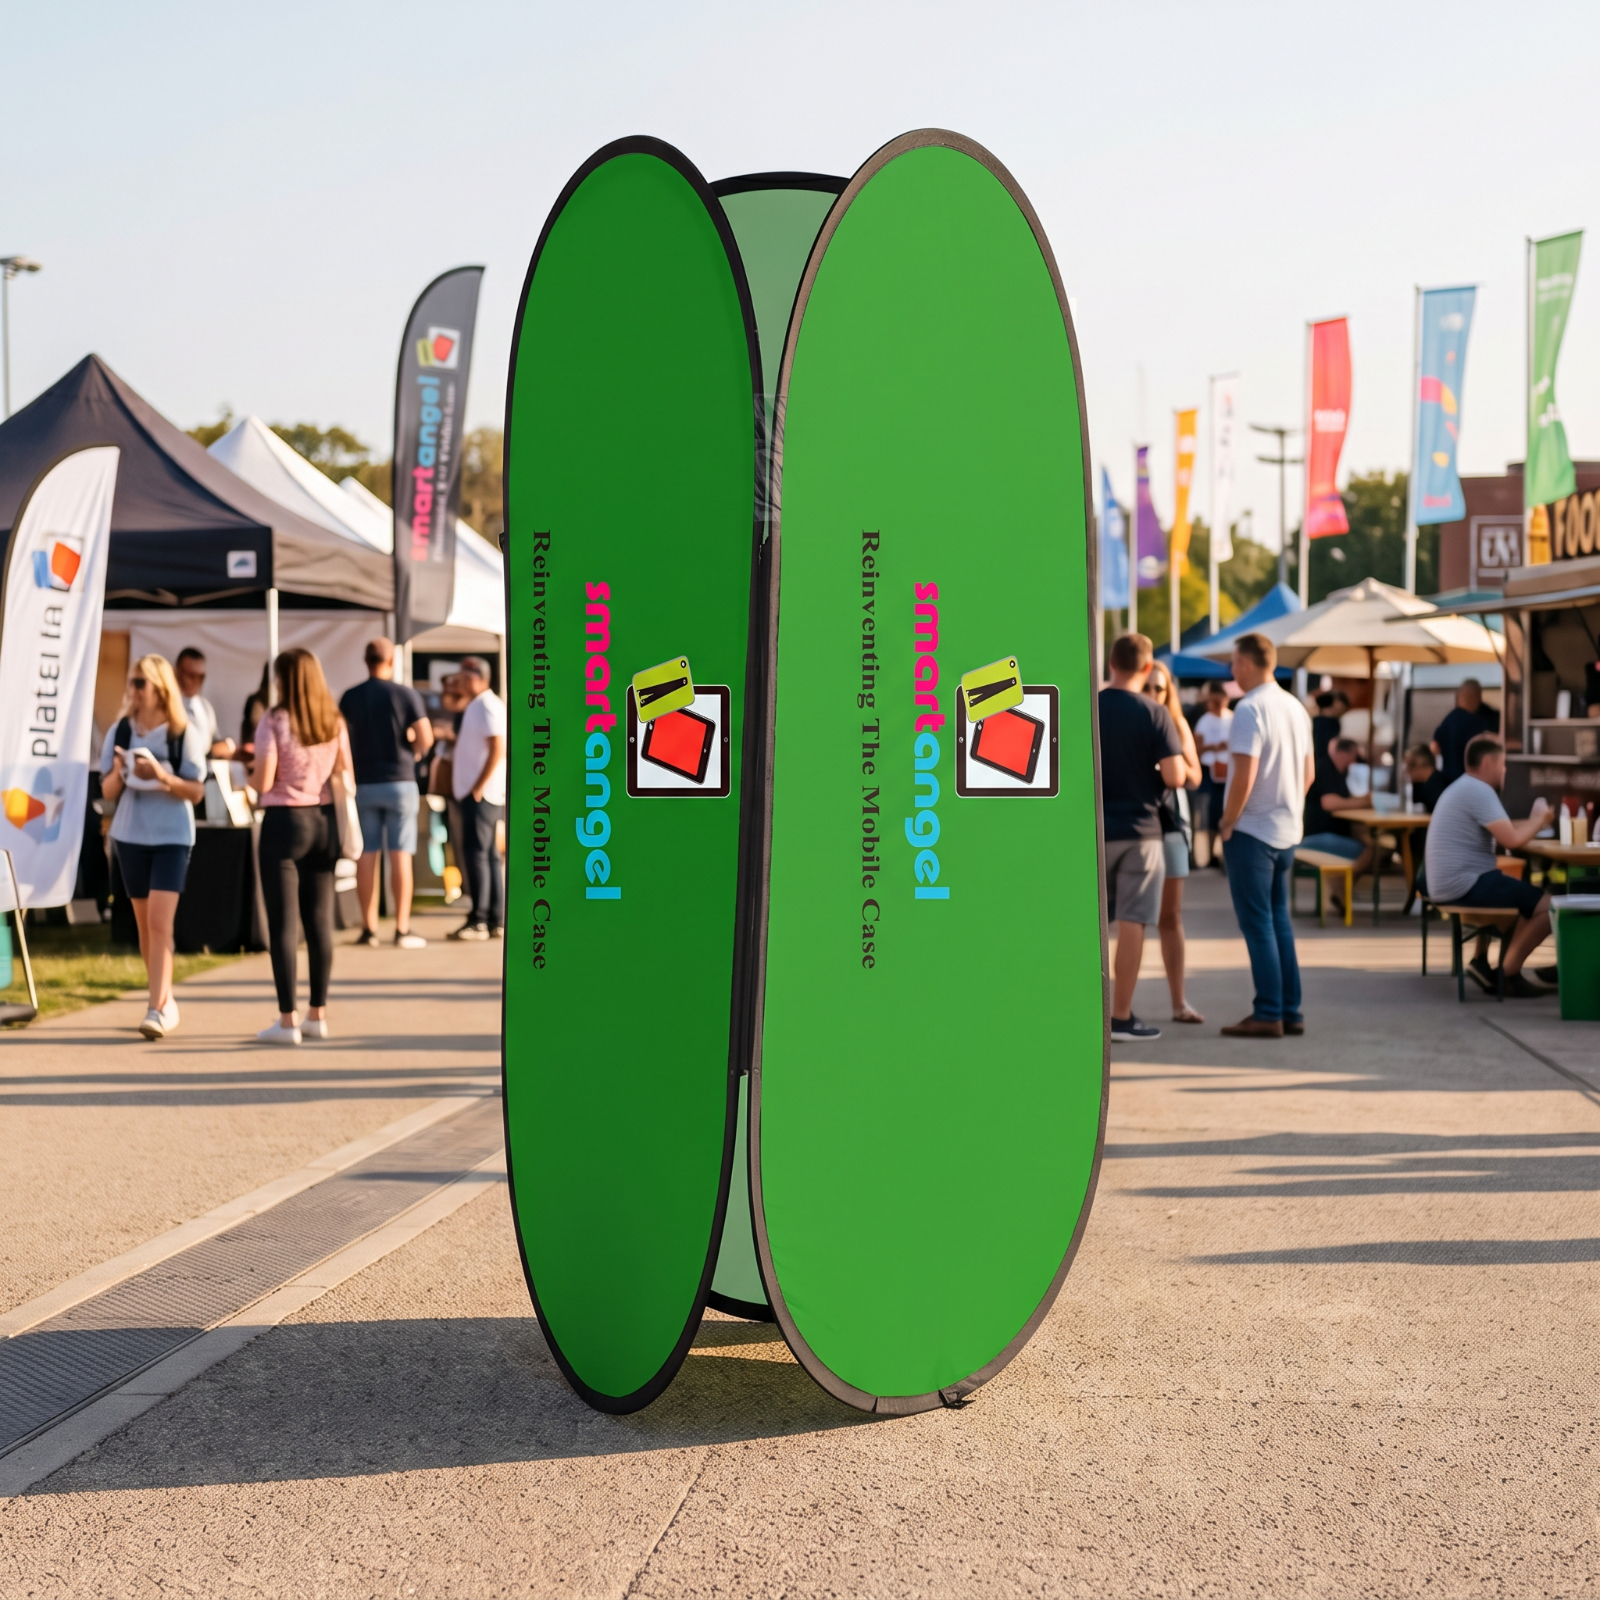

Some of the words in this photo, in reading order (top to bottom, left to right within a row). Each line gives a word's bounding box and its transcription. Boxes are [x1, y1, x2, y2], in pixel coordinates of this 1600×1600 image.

[411, 374, 443, 562] smartangel
[528, 530, 551, 709] Reinventing
[857, 530, 880, 709] Reinventing
[532, 718, 551, 775] The
[576, 582, 621, 900] smartangel
[861, 718, 880, 775] The
[905, 582, 950, 900] smartangel
[532, 787, 551, 888] Mobile
[861, 787, 880, 888] Mobile
[532, 898, 551, 969] Case
[861, 898, 880, 969] Case
